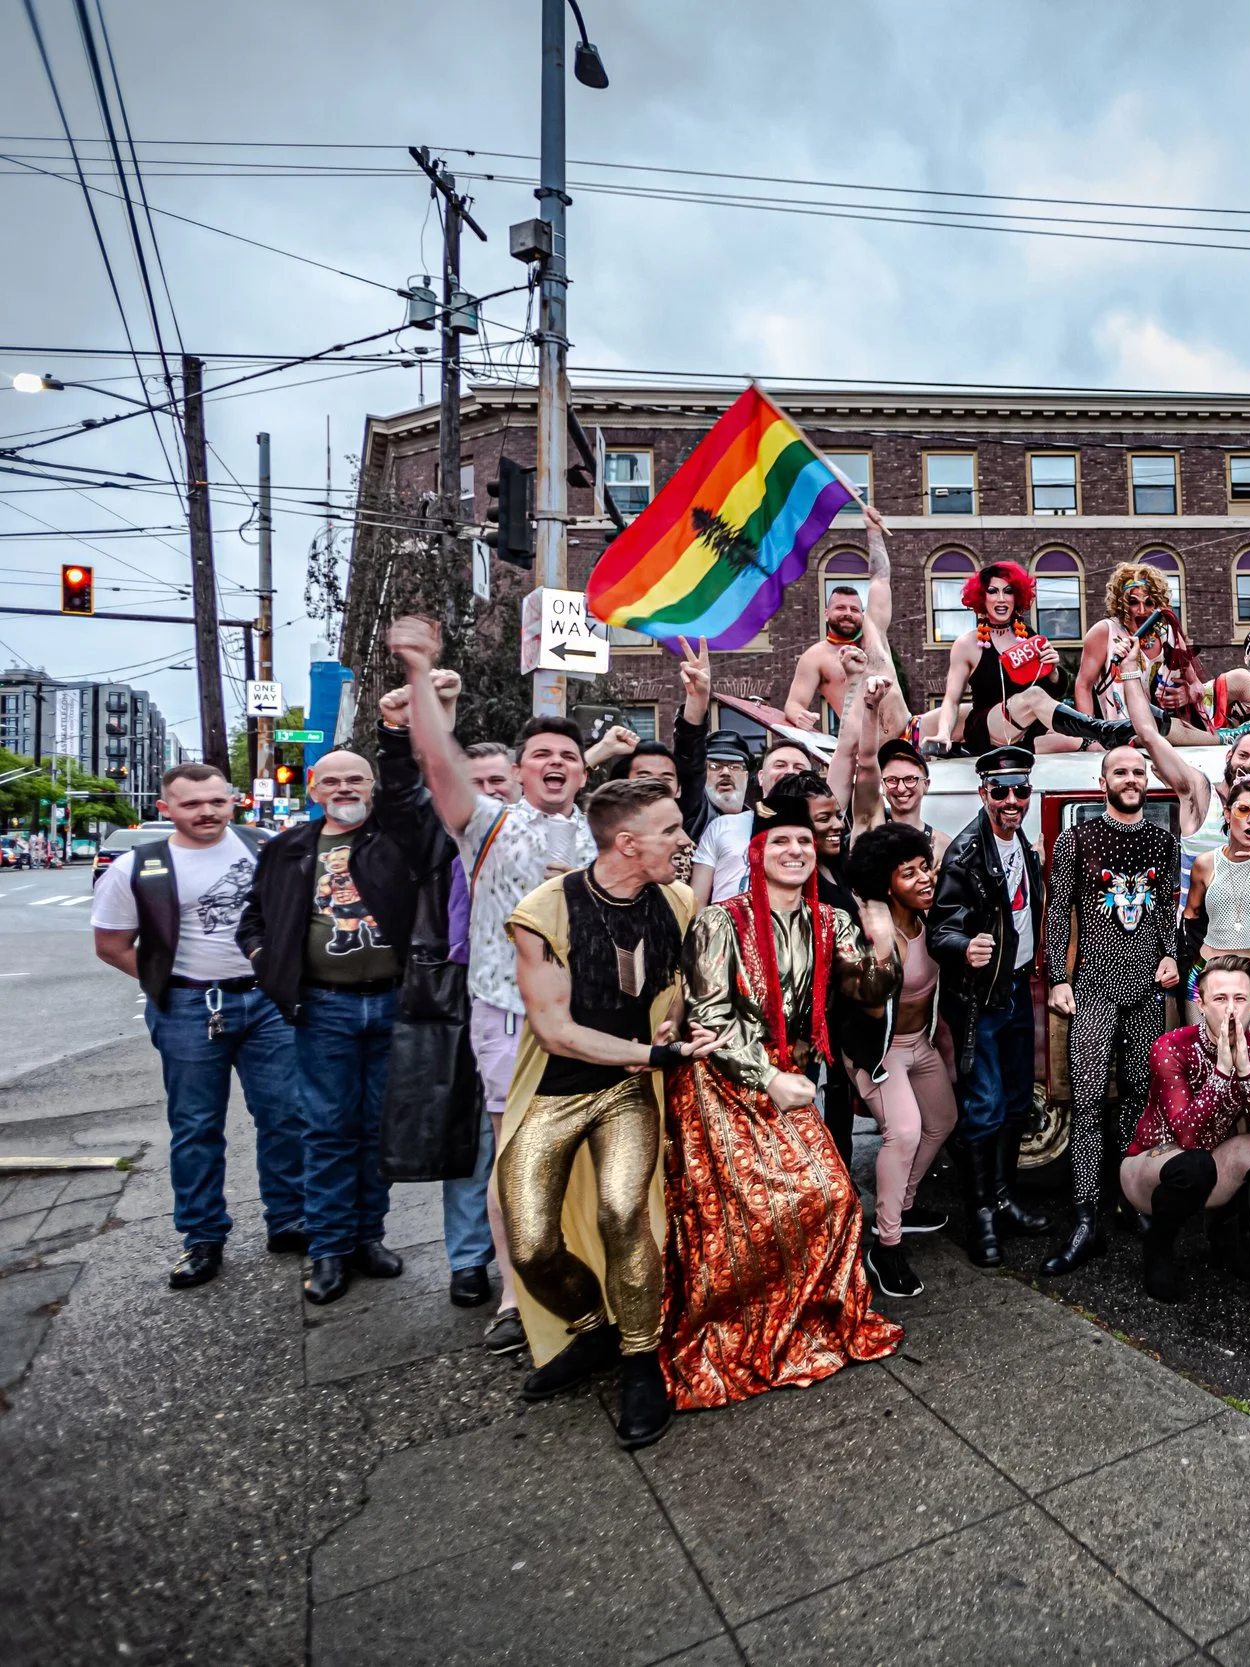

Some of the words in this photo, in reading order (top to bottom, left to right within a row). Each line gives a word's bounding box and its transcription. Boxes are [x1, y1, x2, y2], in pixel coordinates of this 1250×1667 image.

[551, 619, 597, 638] WAY
[254, 684, 276, 692] ONE
[253, 693, 277, 701] WAY
